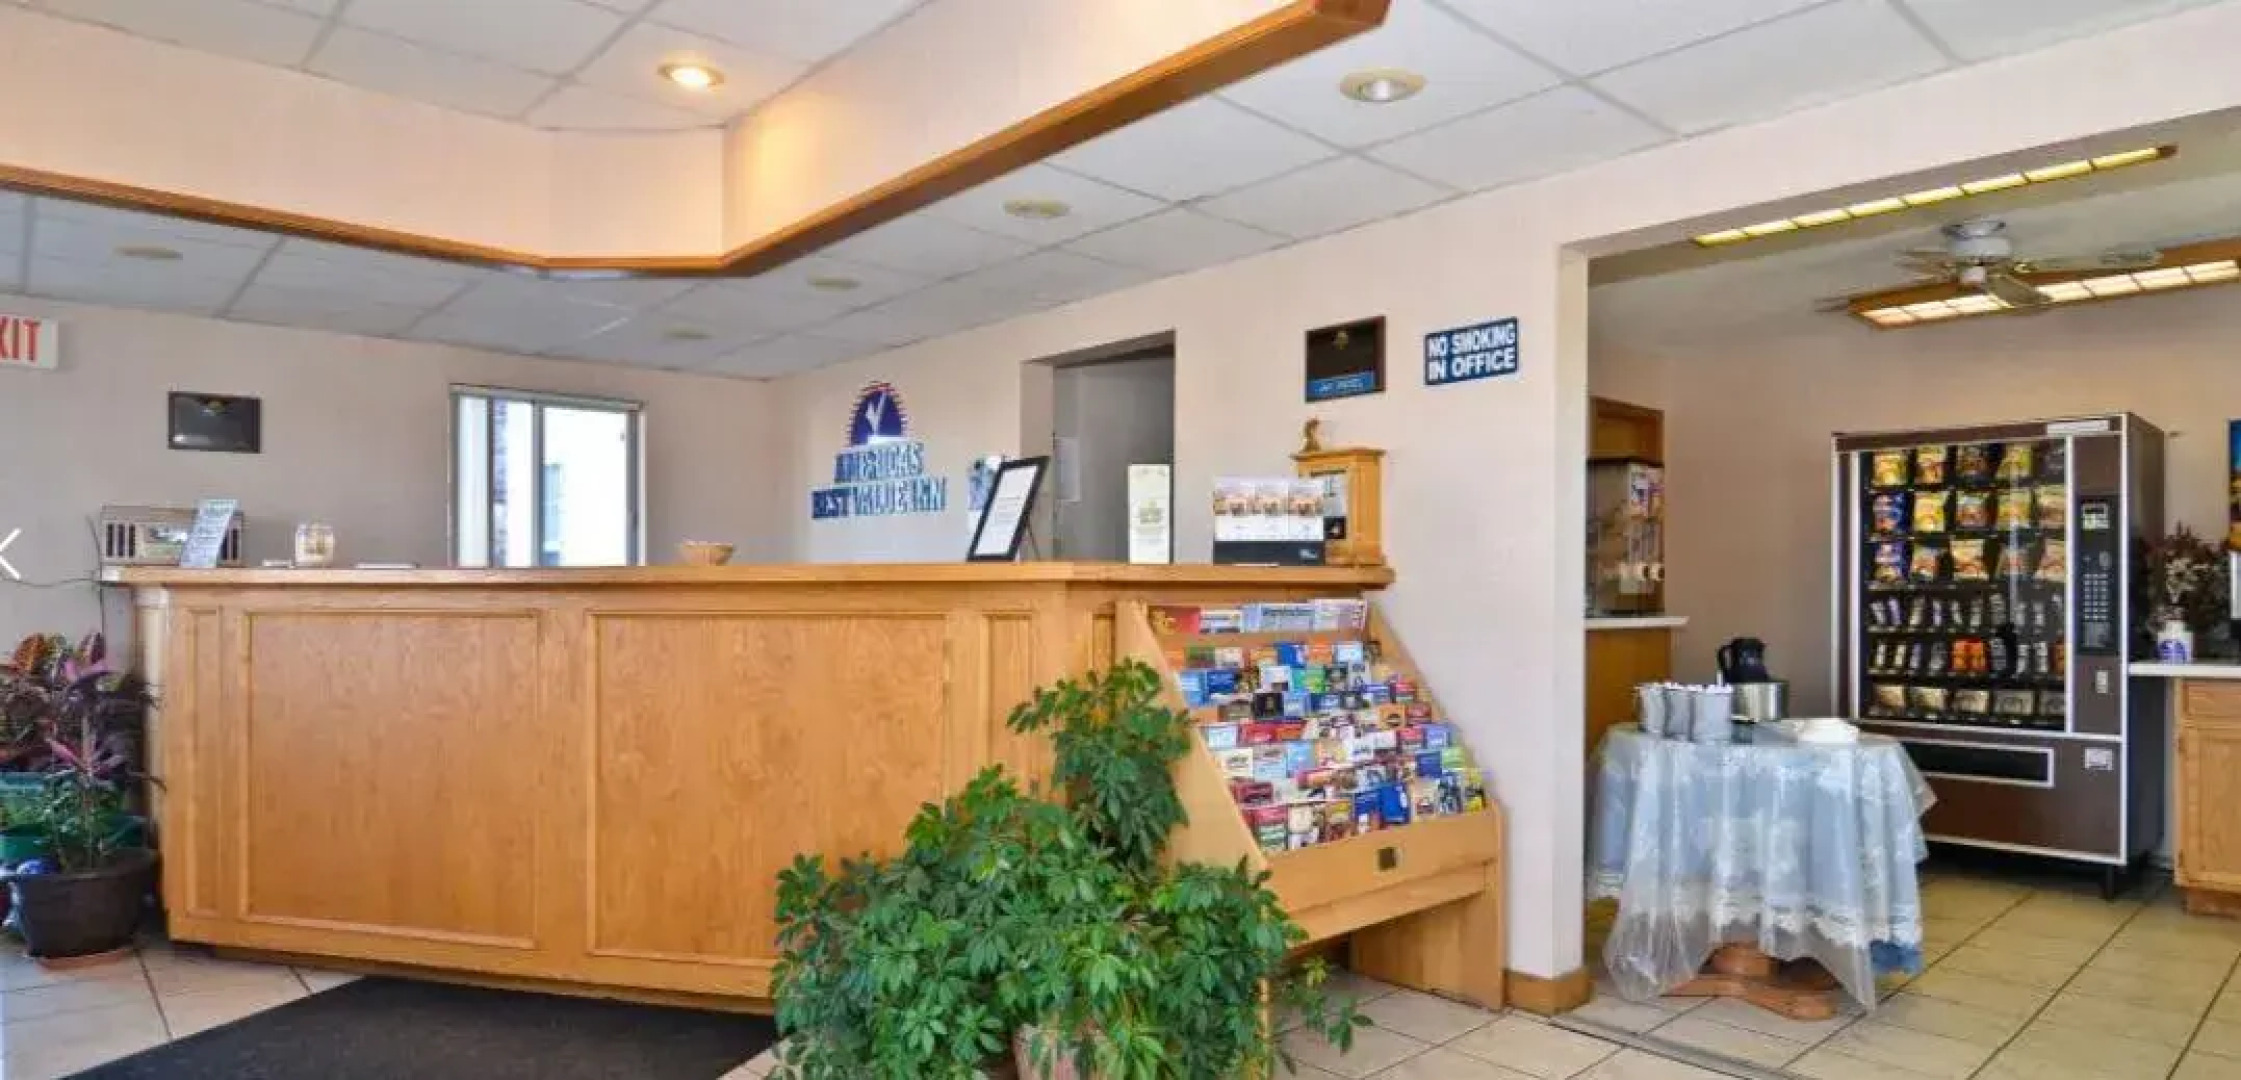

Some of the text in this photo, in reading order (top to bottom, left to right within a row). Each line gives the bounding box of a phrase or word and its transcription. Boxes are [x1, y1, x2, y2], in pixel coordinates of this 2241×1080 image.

[1428, 322, 1516, 358] NO SMOKING
[1428, 346, 1516, 382] IN OFFICE
